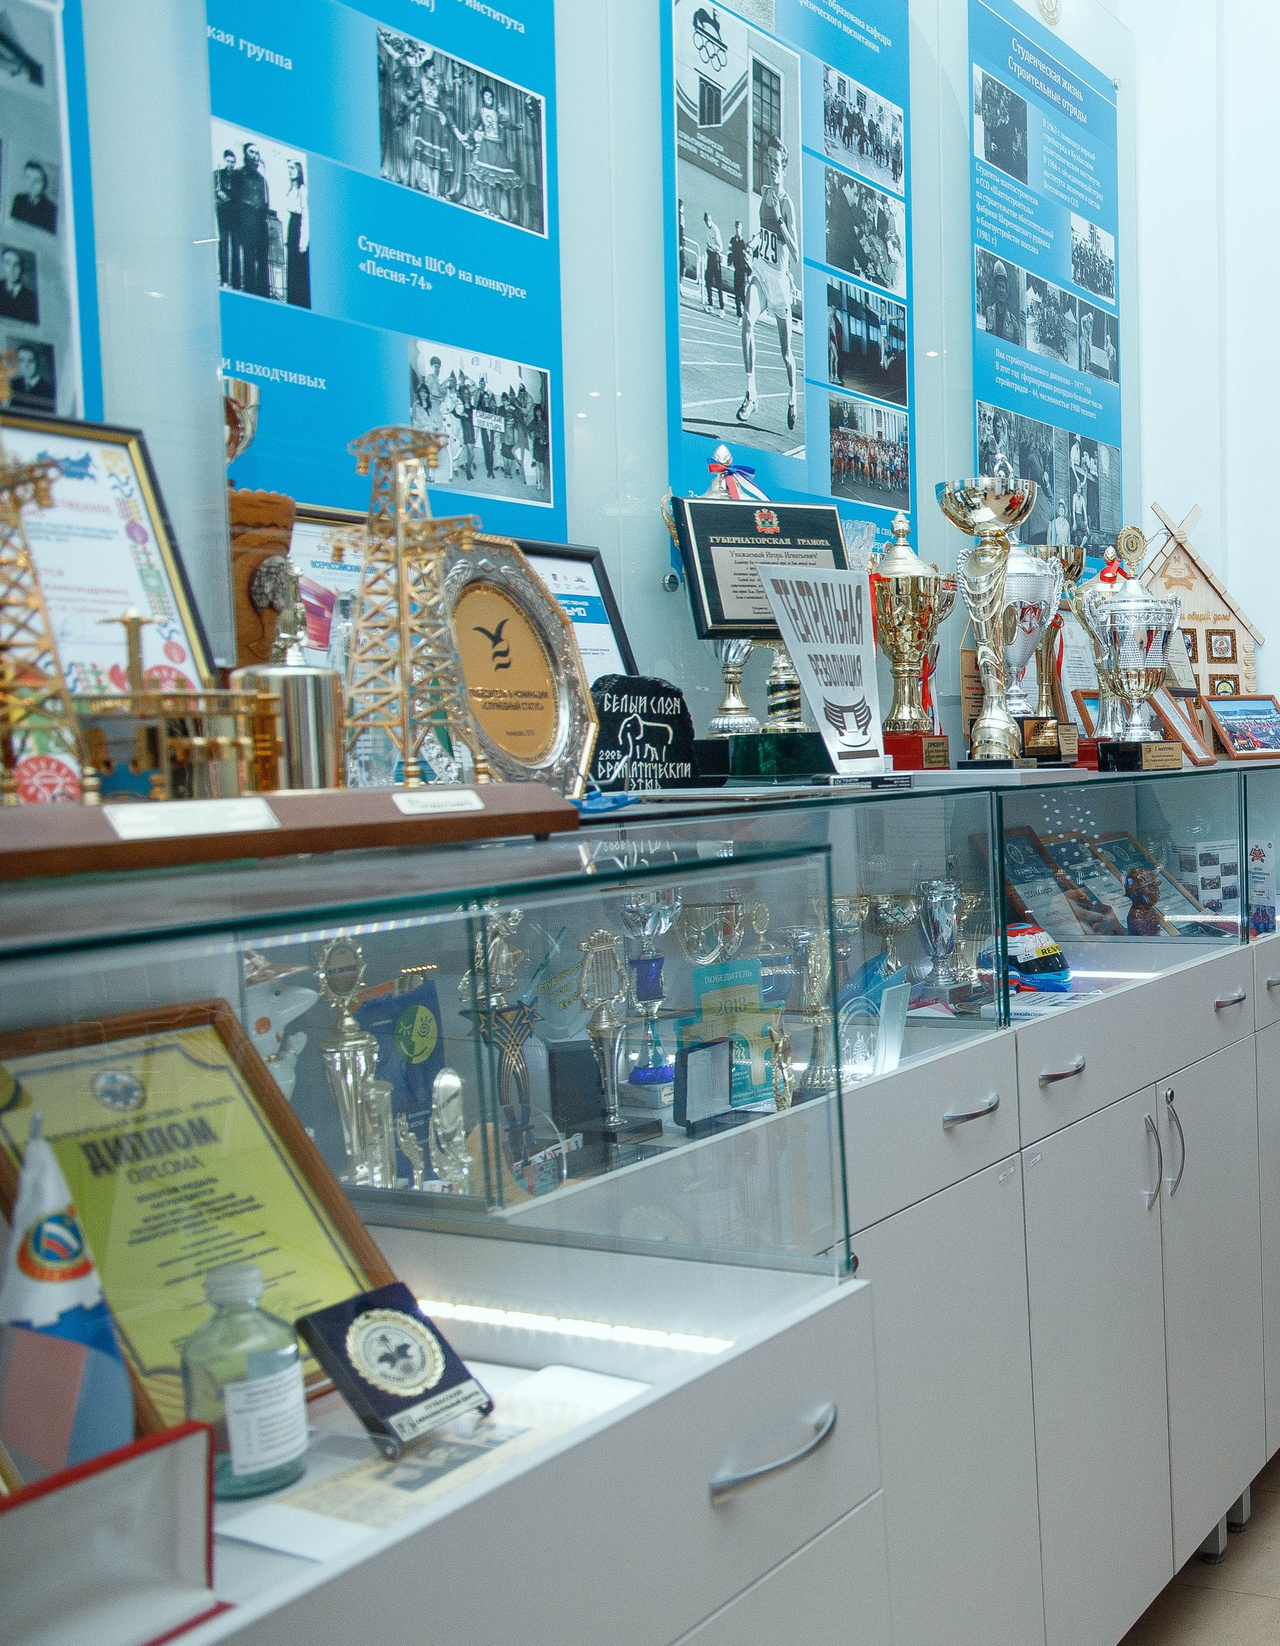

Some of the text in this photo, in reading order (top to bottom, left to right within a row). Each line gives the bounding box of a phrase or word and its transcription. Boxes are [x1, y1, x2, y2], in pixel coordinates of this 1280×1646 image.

[464, 0, 525, 35] института
[842, 24, 880, 54] воспитания
[865, 23, 892, 47] кафедра
[238, 39, 293, 71] группа
[1012, 37, 1084, 101] Студенческая жизнь
[1008, 56, 1087, 124] Строительные отряды
[358, 235, 527, 299] Студенты ШСФ на конкурсе
[358, 260, 433, 292] «Песня-74»
[235, 360, 327, 390] находчивых
[709, 536, 831, 546] ГУБЕРНАТОРСКАЯ ГРАМОТА
[766, 552, 784, 560] Игорь
[770, 578, 864, 645] ТЕАТРАЛЬНАЯ
[807, 654, 864, 691] РЕВОЛЮЦИЯ
[650, 696, 681, 715] СЛОН
[704, 969, 753, 984] ПОБЕДИТЕЛЬ
[716, 997, 748, 1017] 2018
[80, 1116, 220, 1178] ДИПЛОМ
[126, 1155, 205, 1185] DIPLOMA
